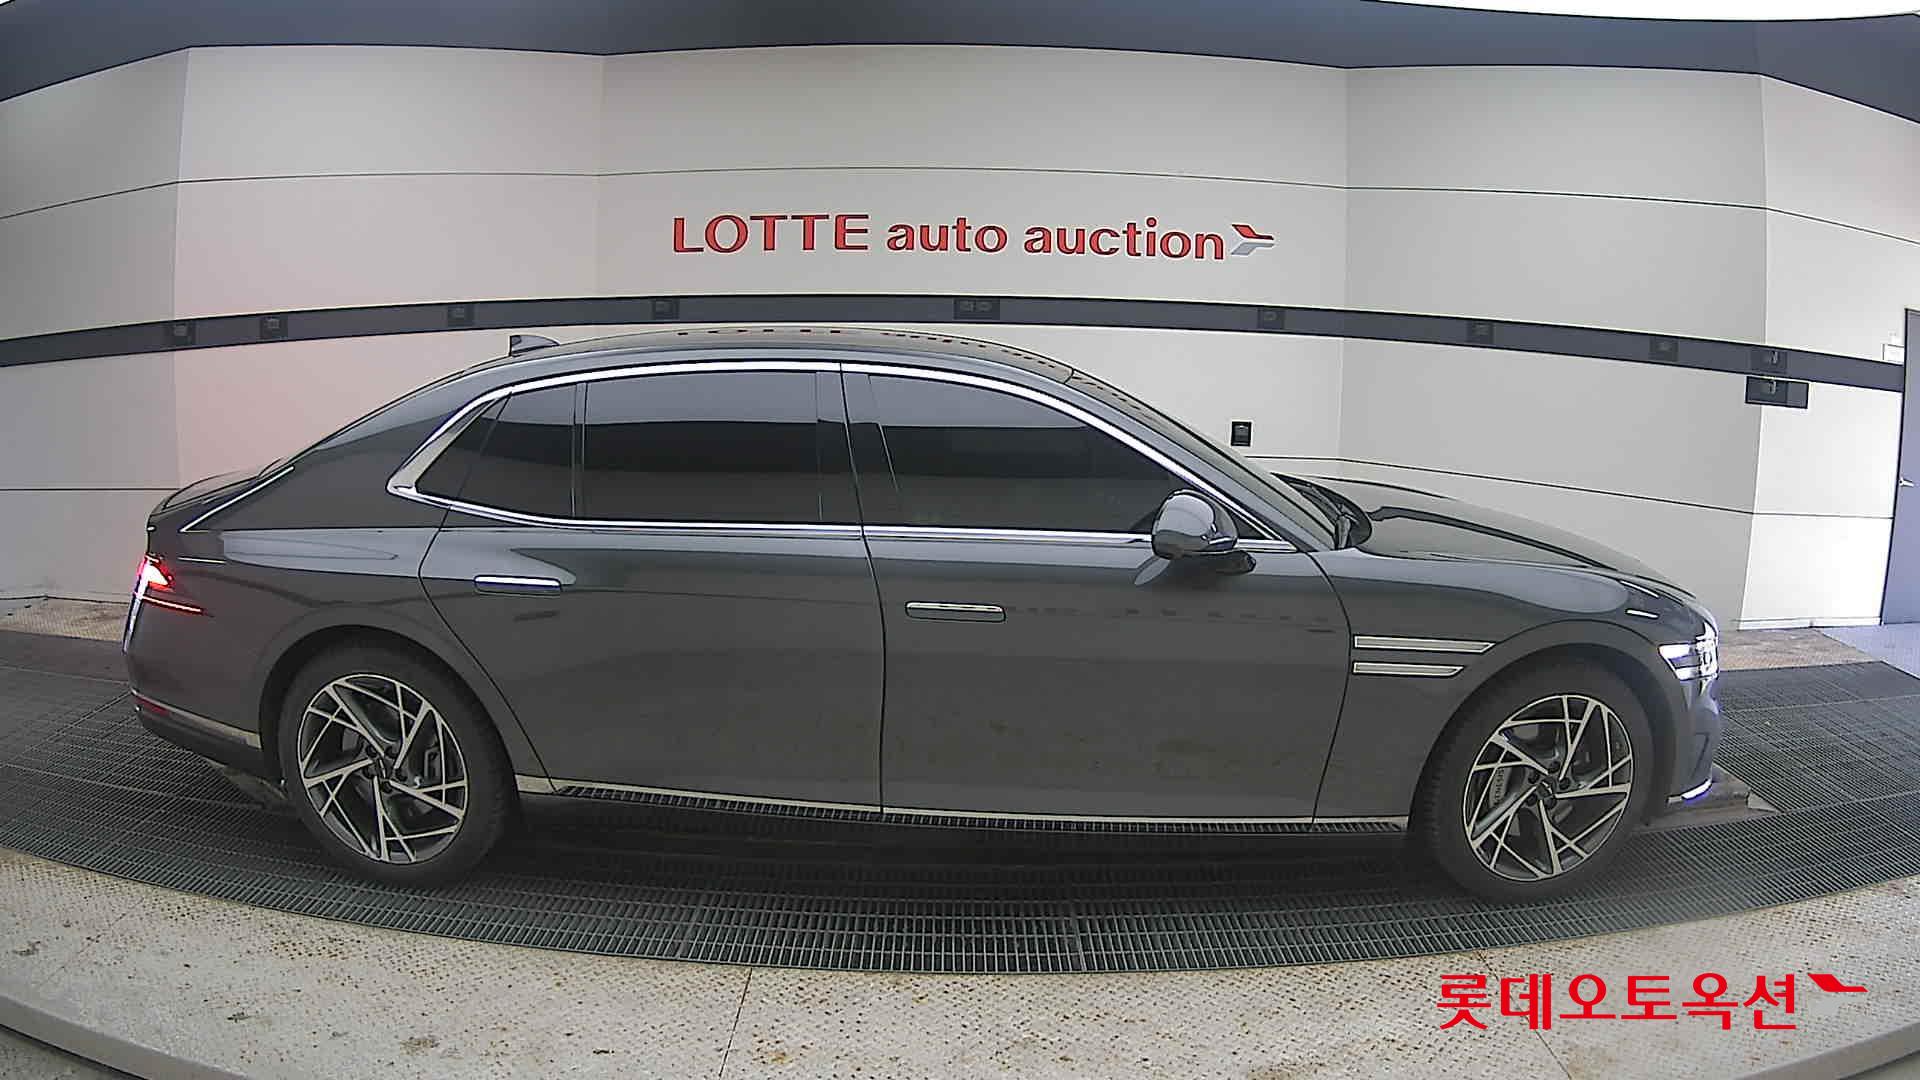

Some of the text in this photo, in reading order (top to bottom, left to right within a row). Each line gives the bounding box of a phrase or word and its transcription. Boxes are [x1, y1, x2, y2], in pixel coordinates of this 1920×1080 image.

[672, 213, 1225, 260] LOTTE auto auction
